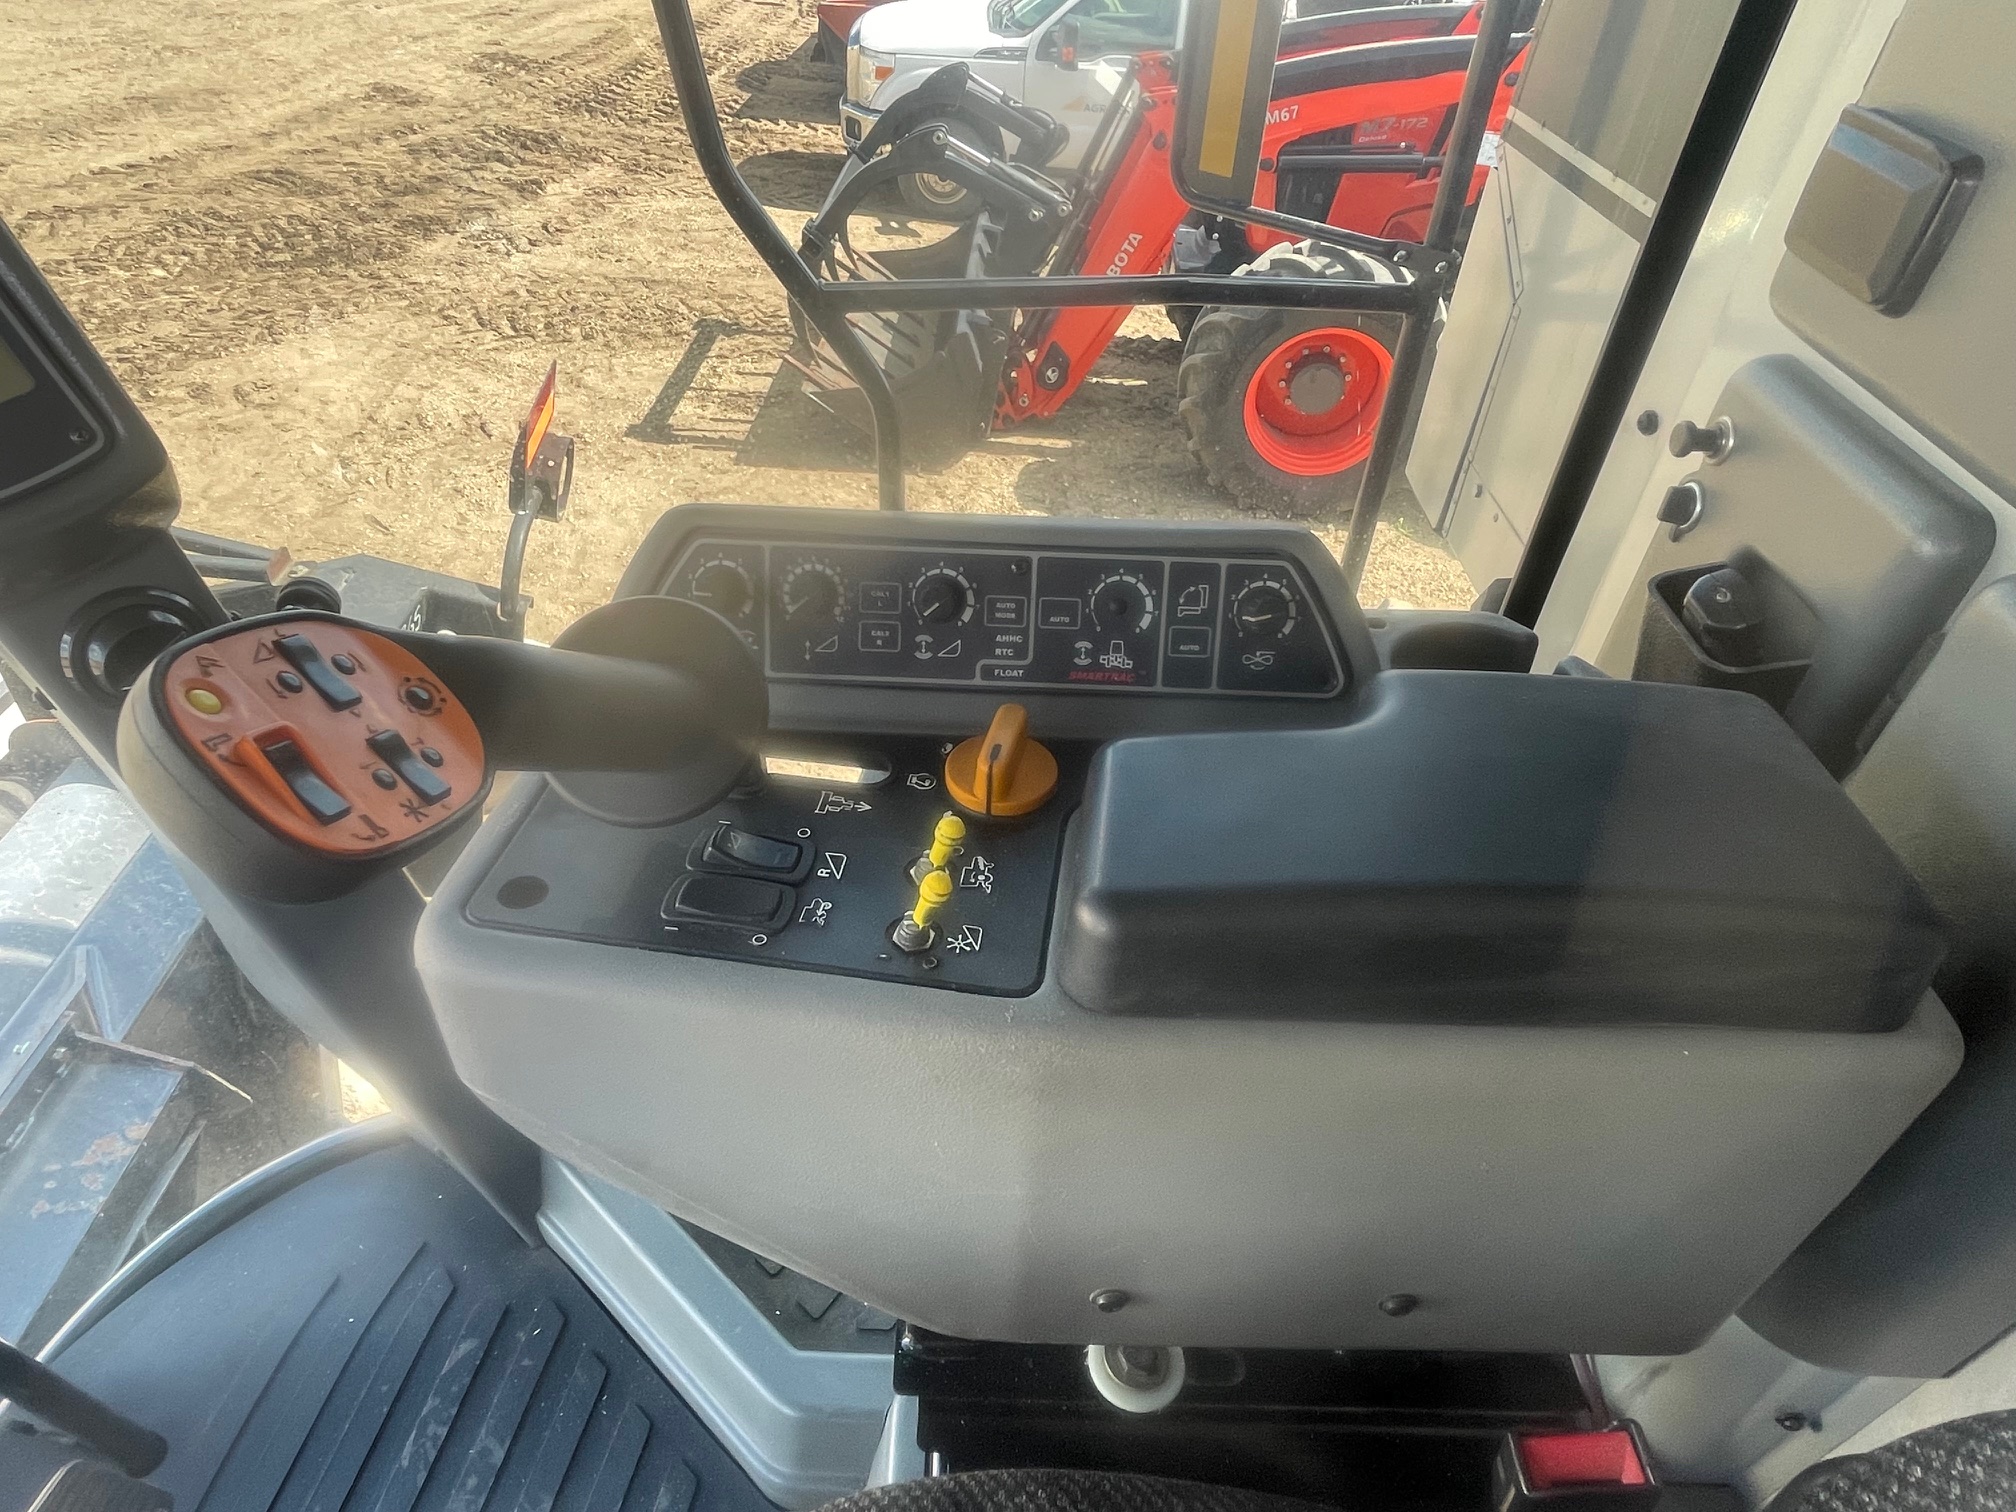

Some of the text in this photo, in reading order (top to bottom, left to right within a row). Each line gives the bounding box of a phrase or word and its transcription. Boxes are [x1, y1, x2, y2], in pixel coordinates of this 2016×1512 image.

[995, 602, 1017, 610] AUTO
[1049, 616, 1071, 624] AUTO
[995, 634, 1023, 643] AHHC
[994, 648, 1014, 656] RTC
[1179, 644, 1201, 652] AUTO
[994, 669, 1024, 678] FLOAT
[817, 867, 831, 877] R
